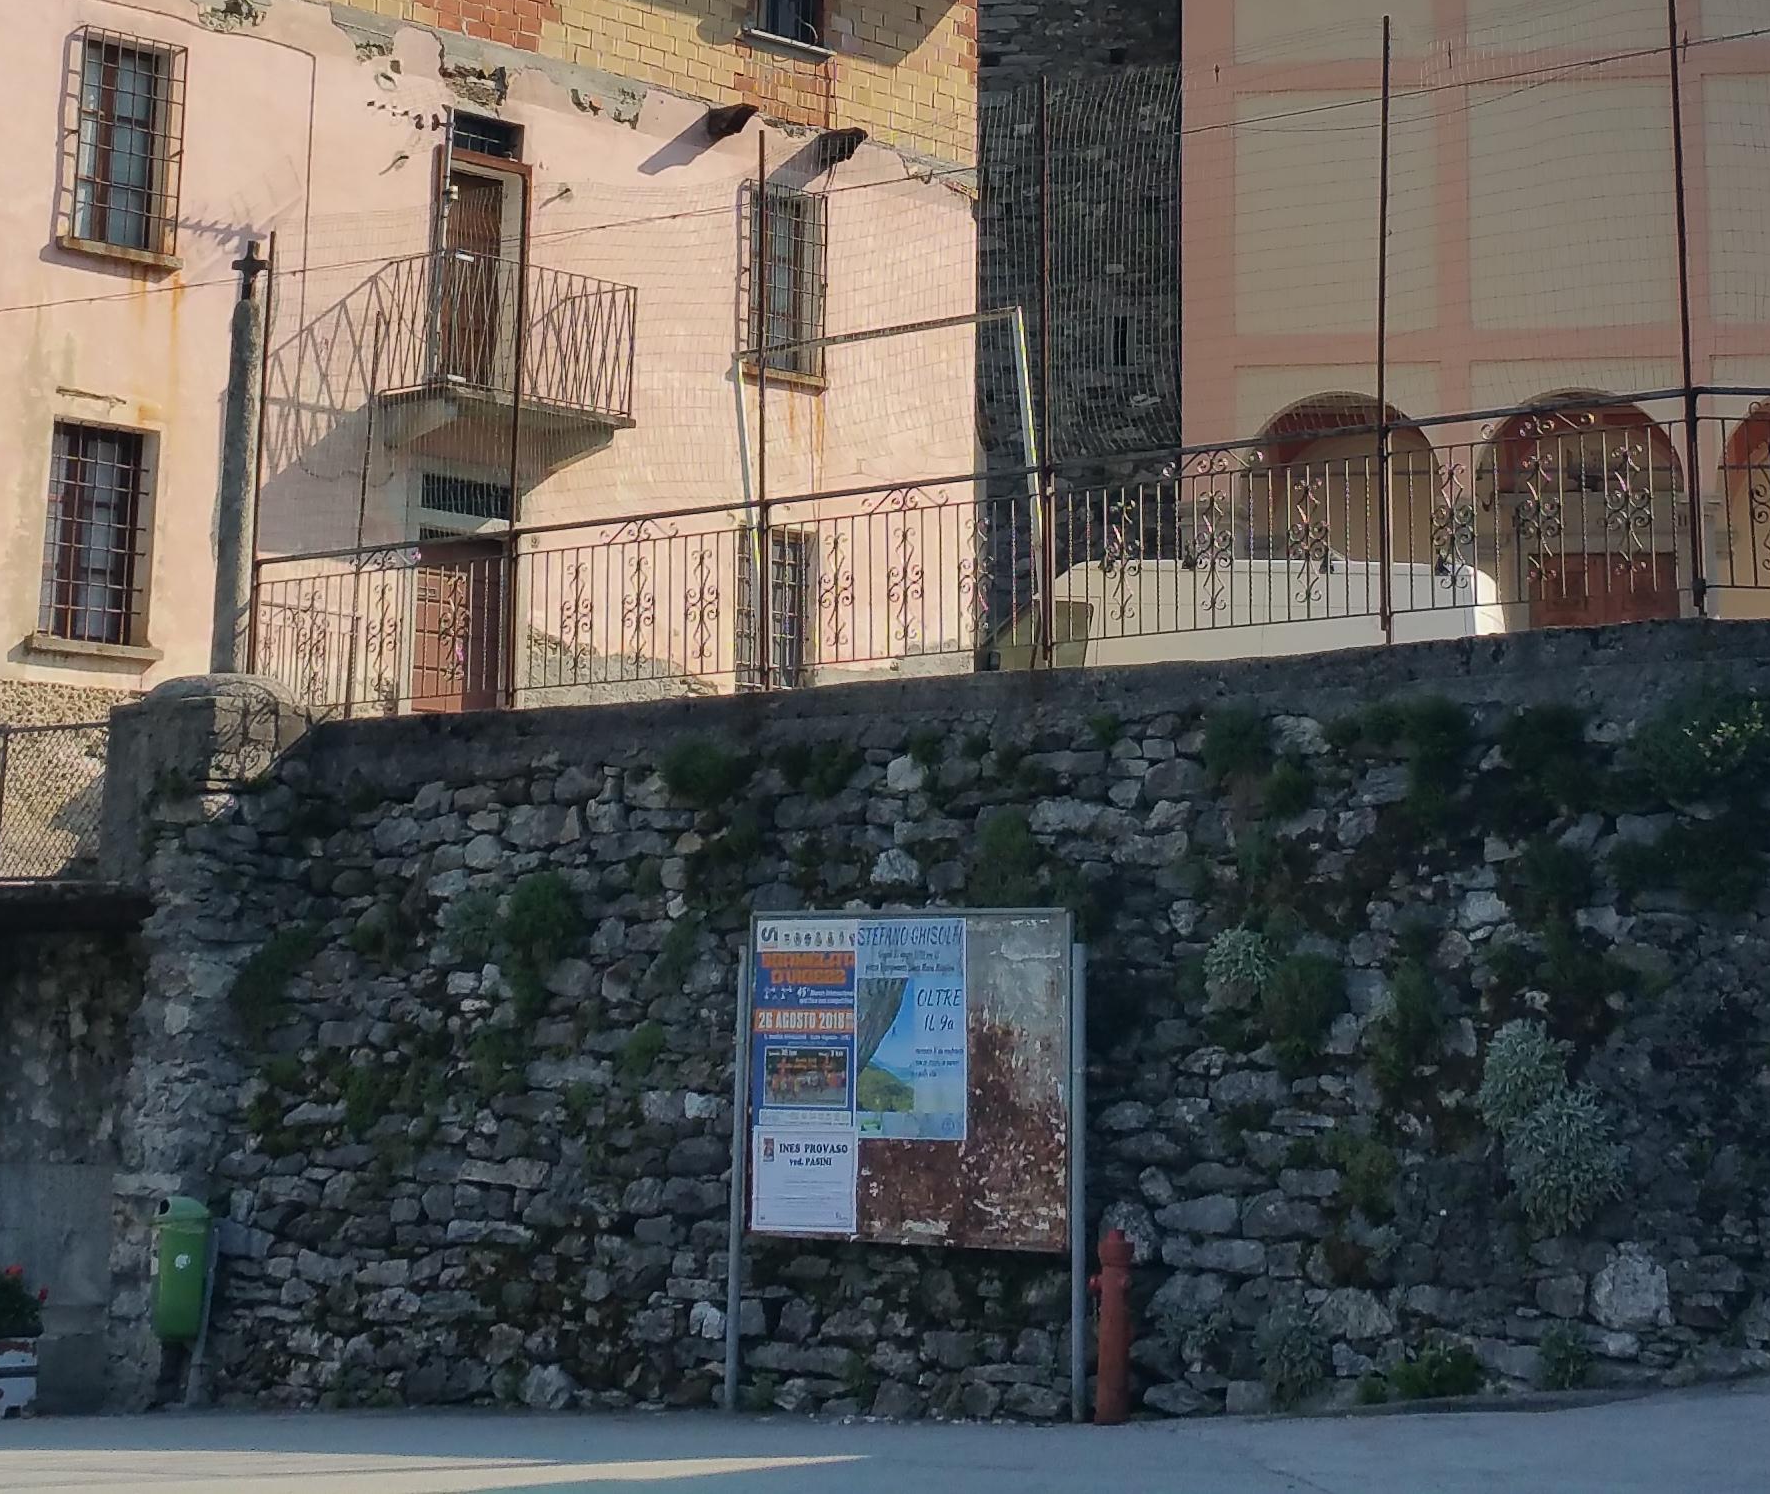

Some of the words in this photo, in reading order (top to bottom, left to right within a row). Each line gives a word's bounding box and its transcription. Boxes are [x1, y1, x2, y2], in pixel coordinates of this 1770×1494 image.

[857, 926, 908, 946] STEFANO
[917, 988, 962, 1007] OLTRE
[758, 1011, 773, 1029] 26
[775, 1011, 816, 1029] AGOSTO
[818, 1012, 845, 1029] 2018
[924, 1014, 935, 1032] IL
[940, 1014, 954, 1031] 9a
[779, 1143, 801, 1154] INES
[804, 1144, 848, 1154] PROVASO
[805, 1157, 832, 1166] PASINI
